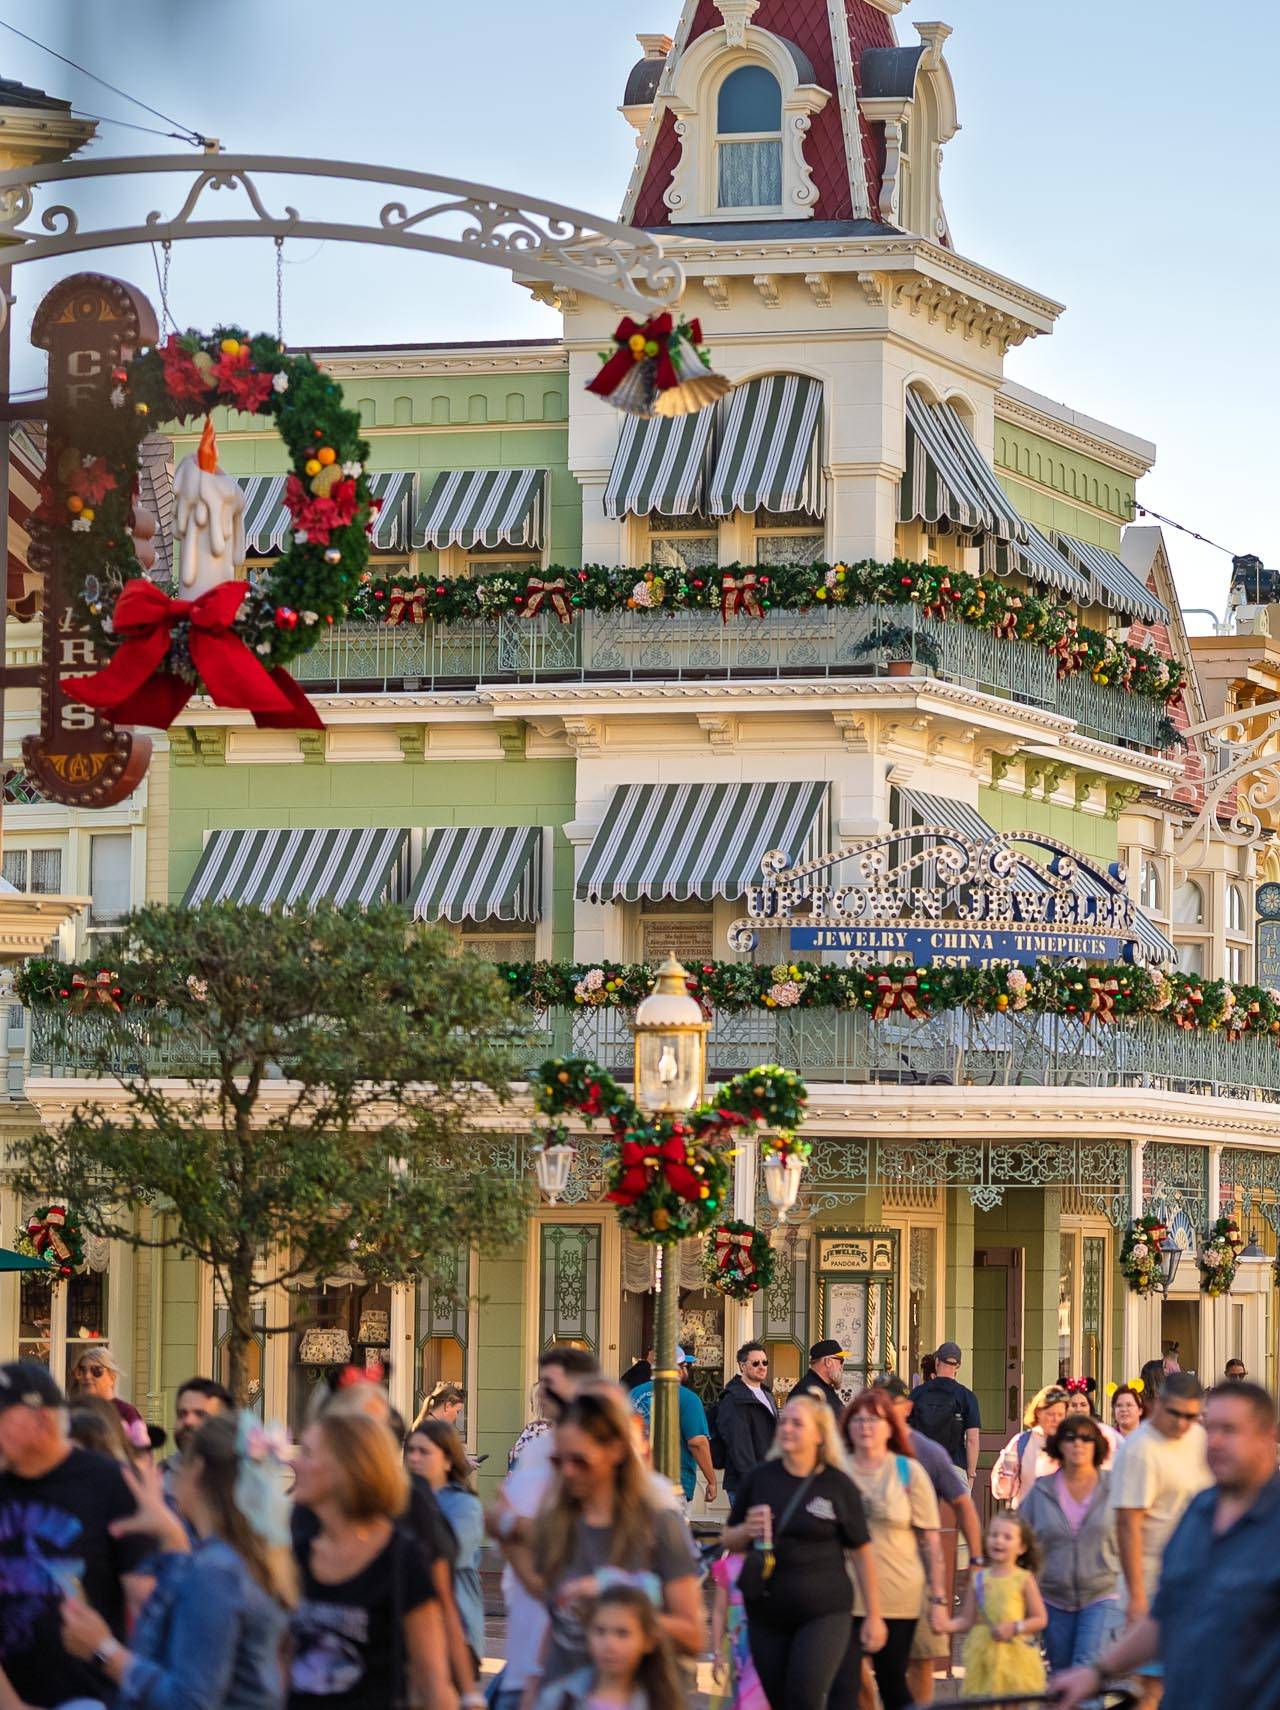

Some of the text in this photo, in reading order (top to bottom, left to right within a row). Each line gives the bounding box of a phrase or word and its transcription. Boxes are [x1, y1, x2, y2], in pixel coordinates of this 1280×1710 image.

[745, 886, 1136, 930] UPTOWN JEWELERS
[813, 931, 1106, 955] JEWELRY CHINA TIMEPIECES
[823, 1248, 868, 1264] JEWELERS
